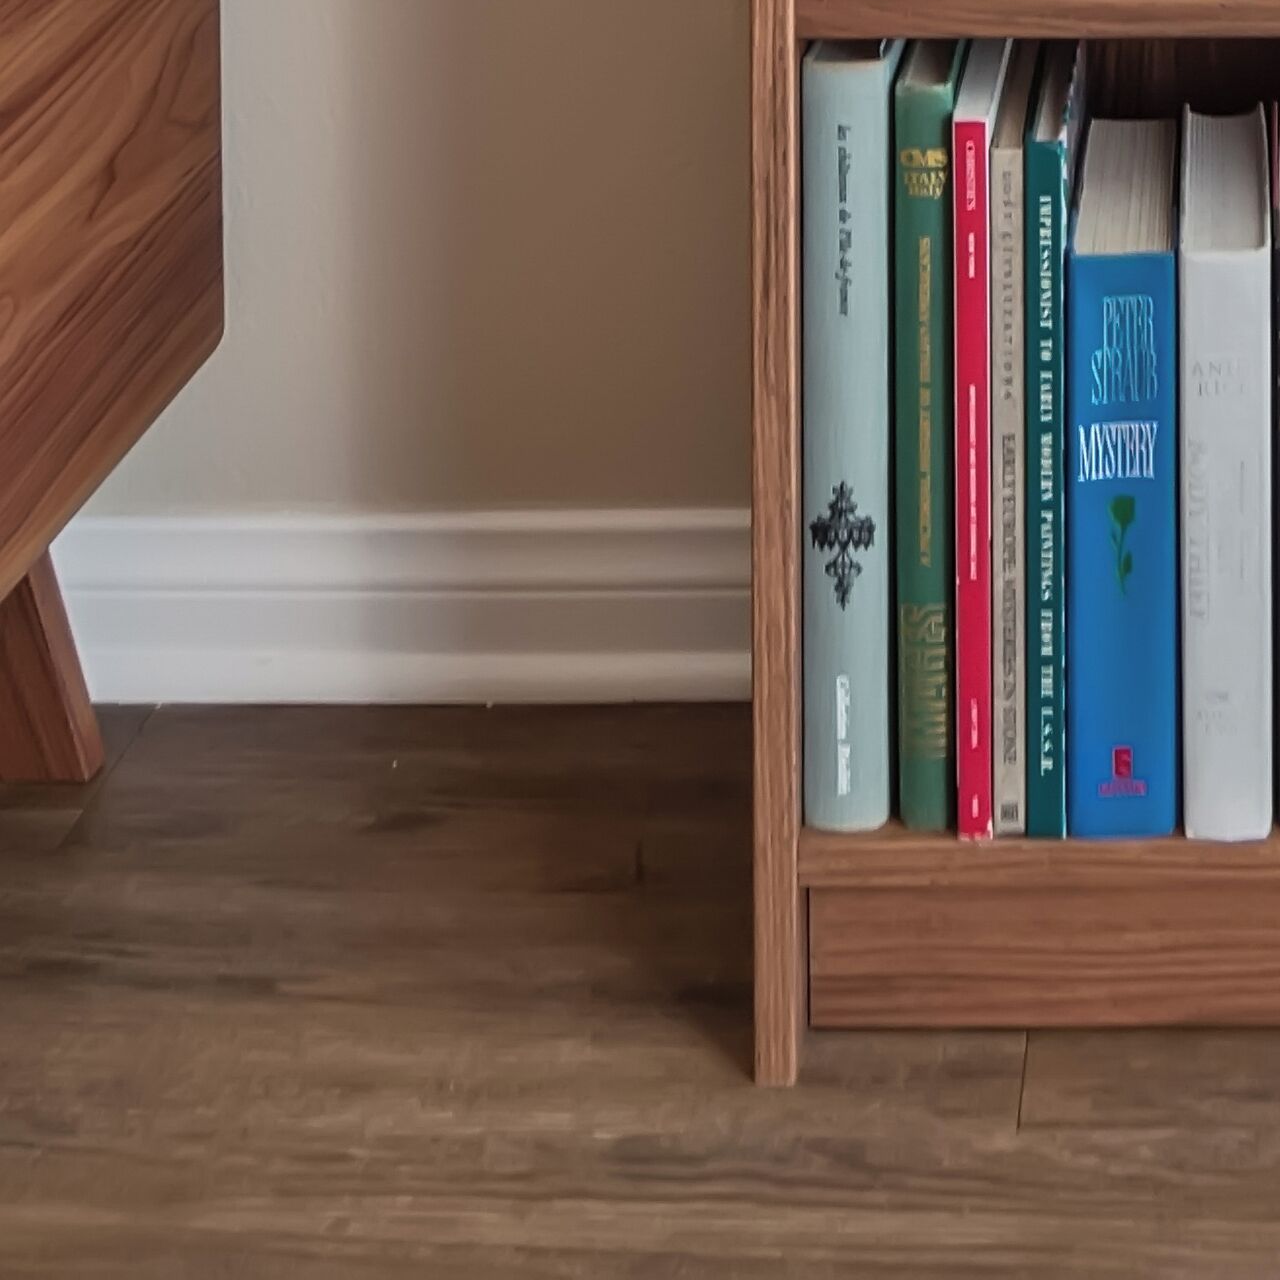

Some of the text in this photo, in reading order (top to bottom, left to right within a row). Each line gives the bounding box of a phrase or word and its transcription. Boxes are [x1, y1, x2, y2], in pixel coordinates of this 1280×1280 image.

[1103, 294, 1155, 349] PETER
[1090, 348, 1158, 406] STRAUB
[1077, 420, 1159, 483] MYSTERY
